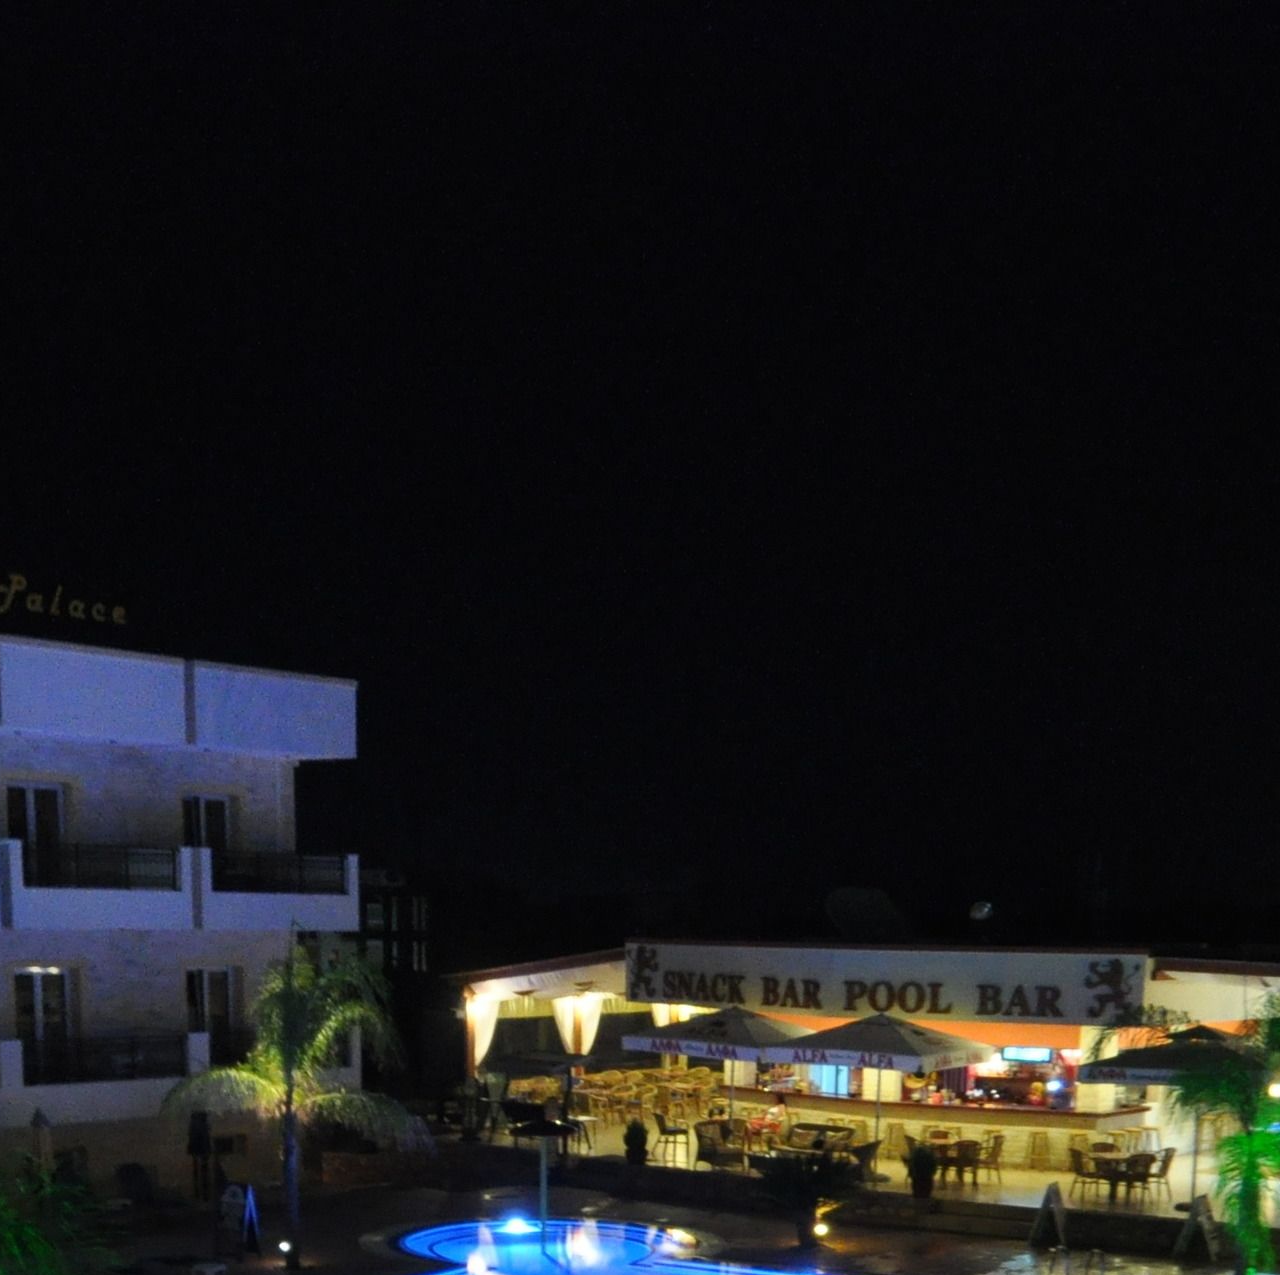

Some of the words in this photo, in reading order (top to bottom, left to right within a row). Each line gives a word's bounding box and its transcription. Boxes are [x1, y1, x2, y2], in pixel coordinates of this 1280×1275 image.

[663, 970, 745, 1005] SNACK
[760, 976, 823, 1010] BAR
[843, 980, 951, 1015] POOL
[975, 983, 1064, 1018] BAR
[791, 1048, 828, 1064] ALFA
[857, 1052, 894, 1070] ALFA
